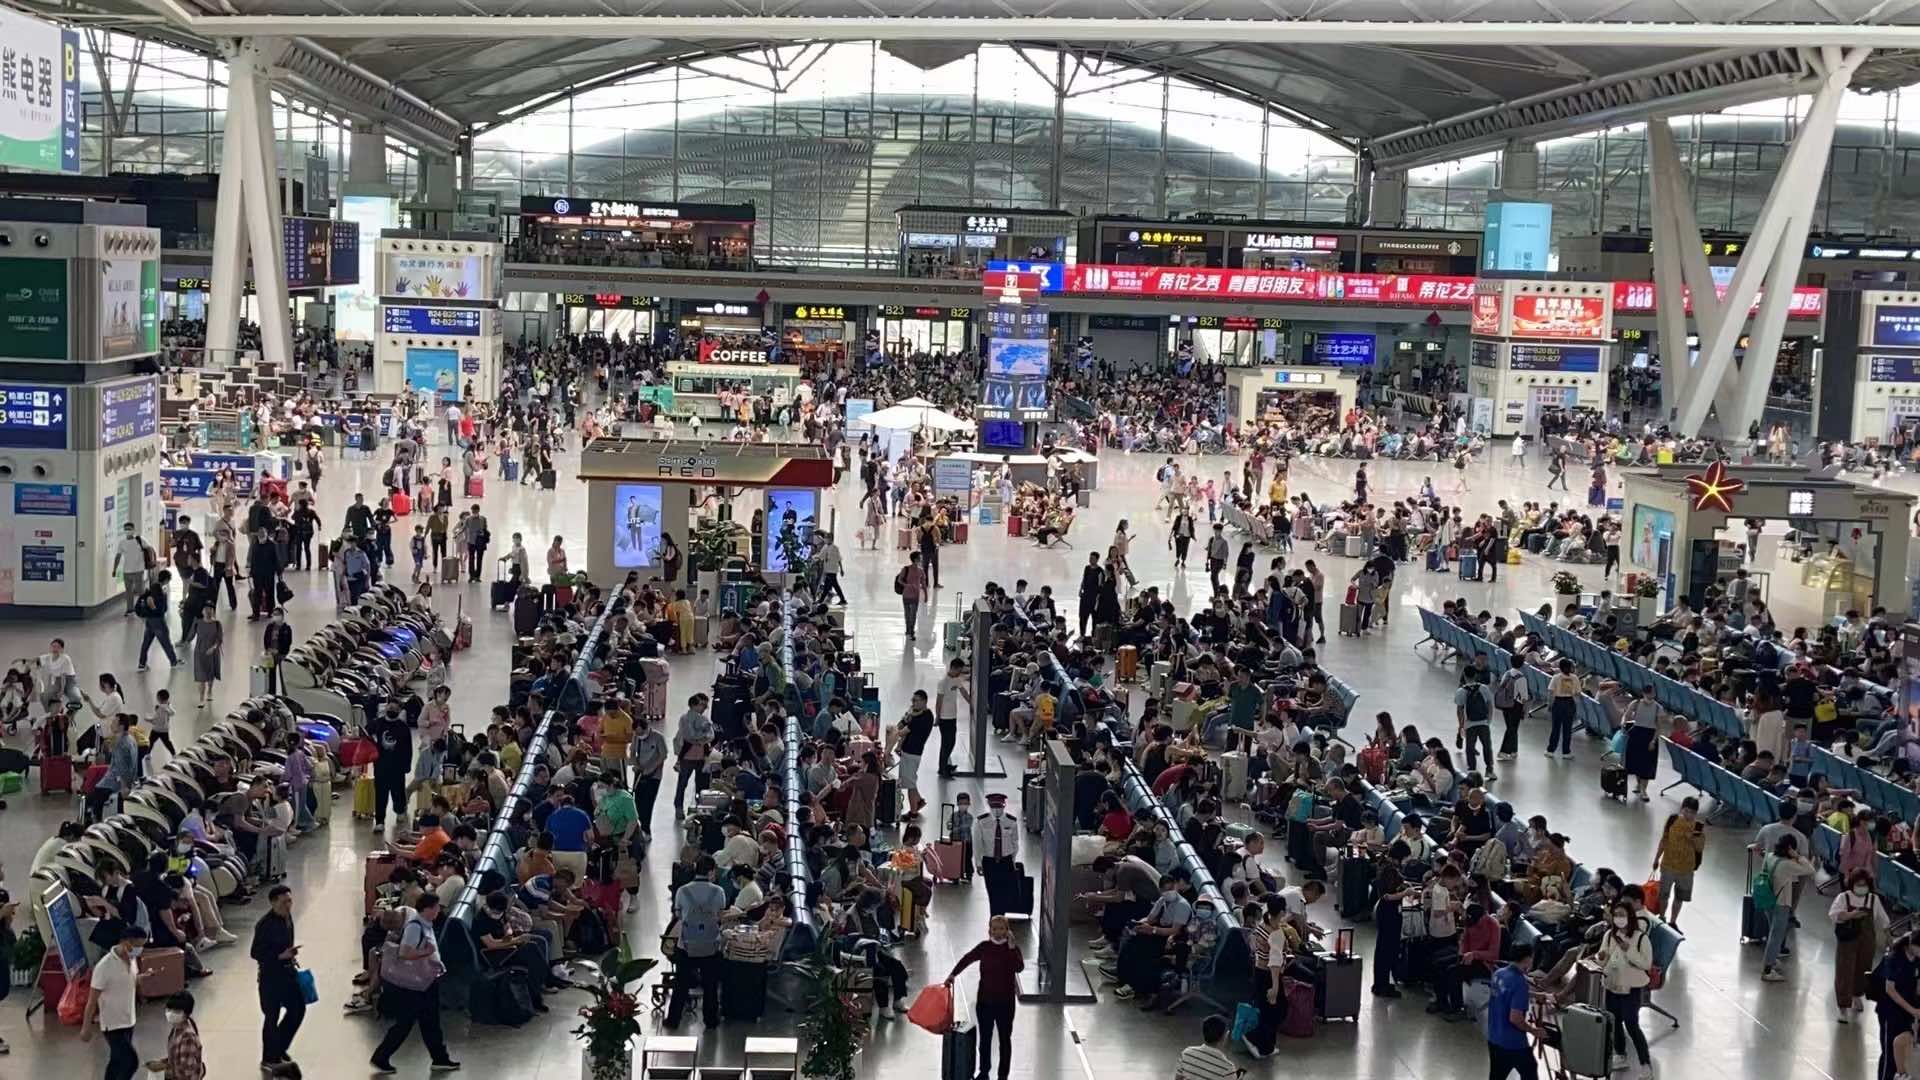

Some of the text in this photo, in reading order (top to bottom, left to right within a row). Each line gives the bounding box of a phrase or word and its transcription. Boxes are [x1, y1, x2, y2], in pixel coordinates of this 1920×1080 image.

[65, 43, 75, 82] B
[65, 88, 75, 122] 区
[179, 280, 199, 288] B27
[1228, 275, 1305, 294] 青春好朋友
[632, 297, 651, 305] B24
[886, 305, 905, 315] B23
[951, 308, 969, 317] B22
[1200, 316, 1218, 326] B21
[1264, 319, 1282, 328] B20
[1623, 329, 1640, 339] B18
[710, 350, 767, 362] COFFEE
[658, 466, 715, 478] RED
